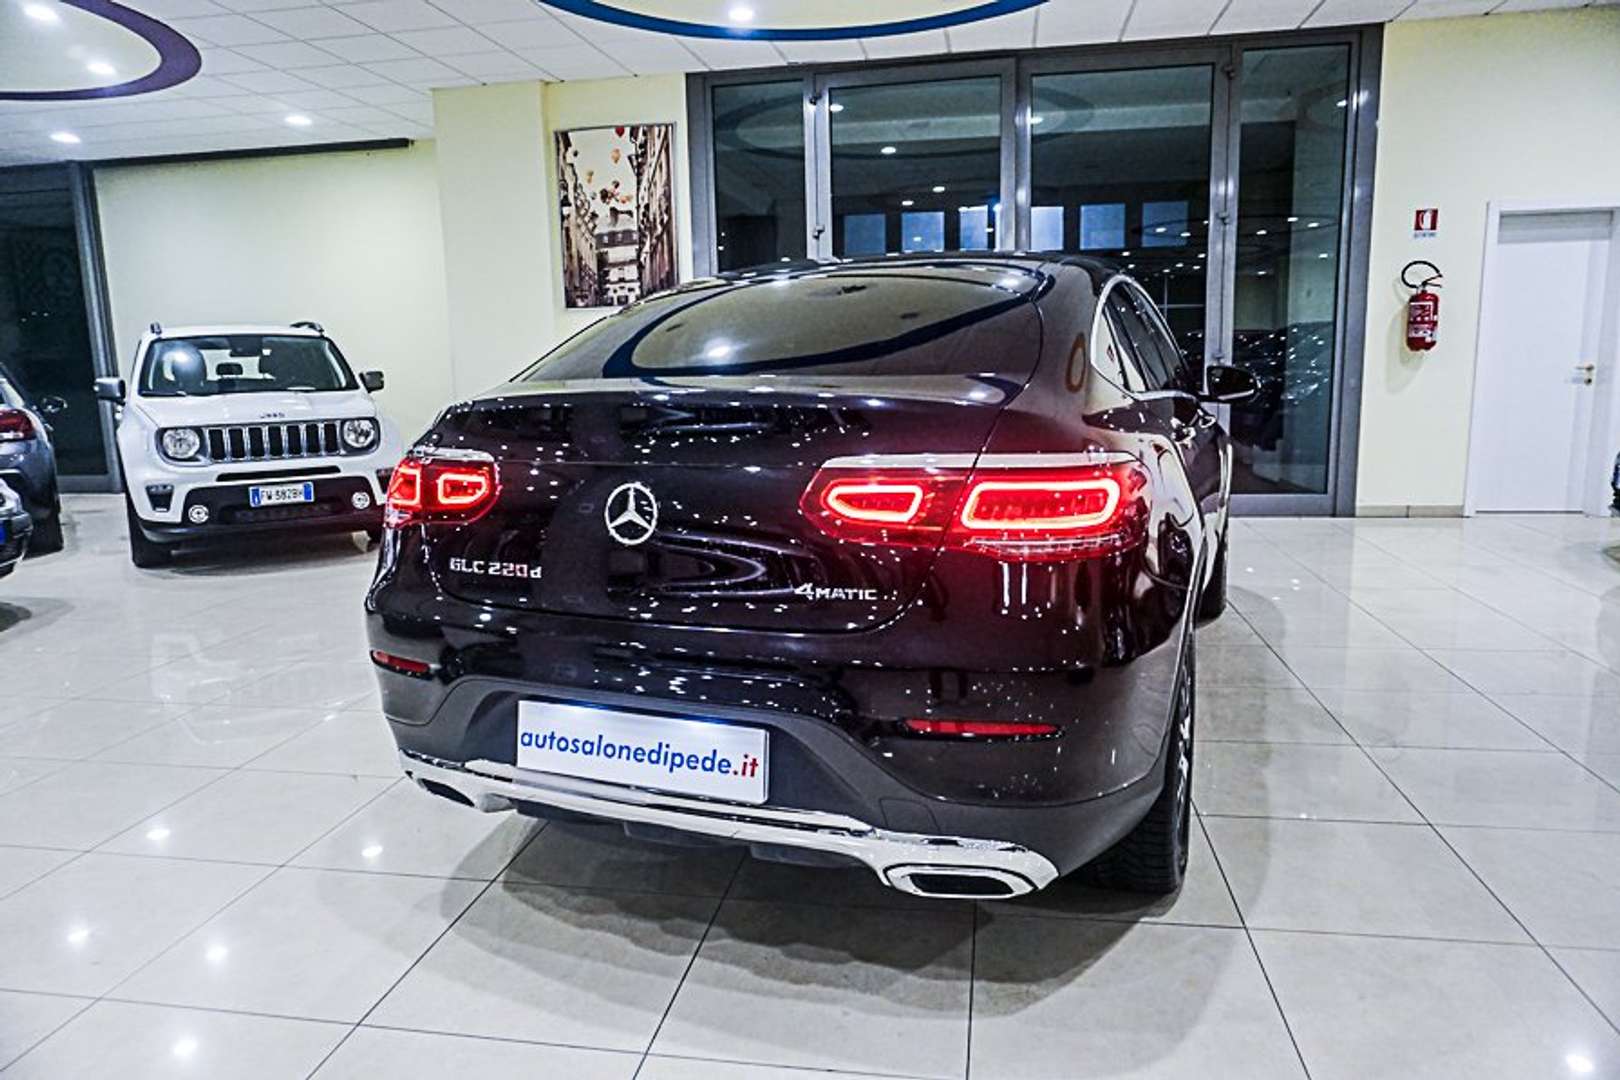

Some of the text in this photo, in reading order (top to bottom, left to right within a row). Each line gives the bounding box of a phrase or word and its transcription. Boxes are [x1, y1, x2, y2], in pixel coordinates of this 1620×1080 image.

[449, 557, 485, 575] GLC
[794, 582, 878, 601] 4MATIC
[520, 730, 760, 778] autosalonedipede.it
